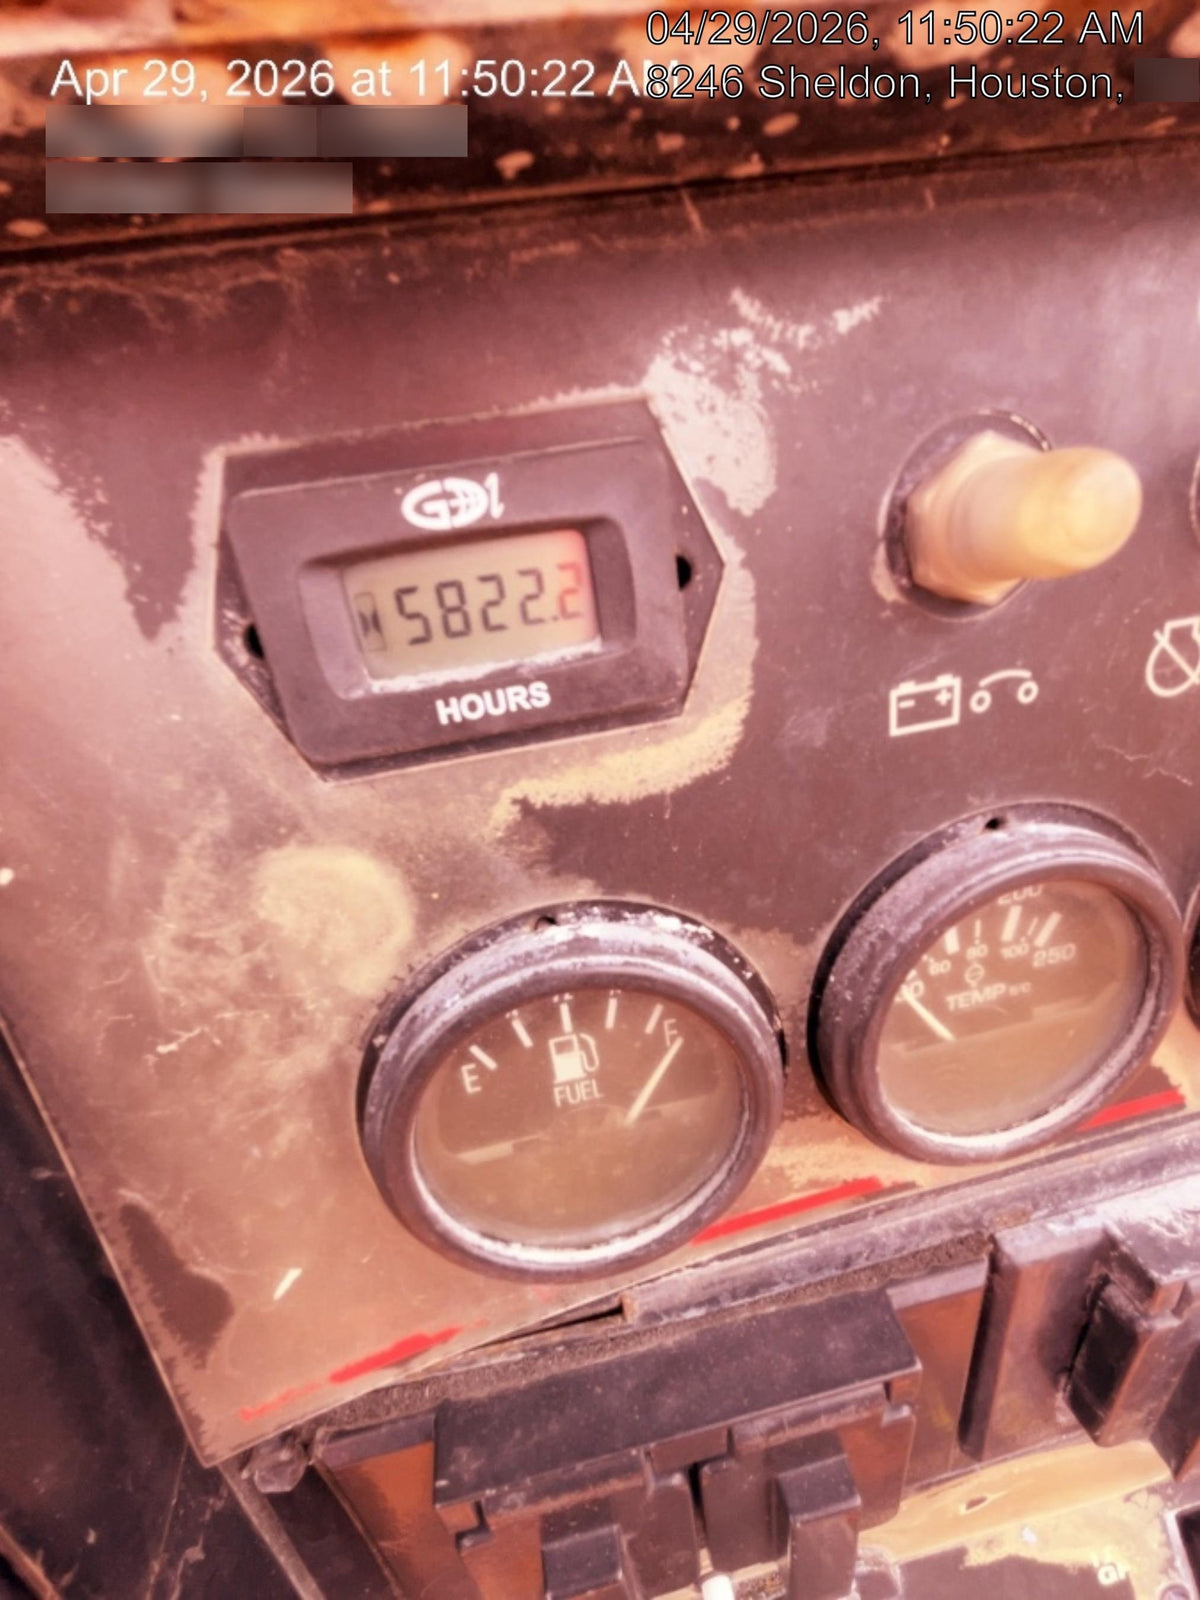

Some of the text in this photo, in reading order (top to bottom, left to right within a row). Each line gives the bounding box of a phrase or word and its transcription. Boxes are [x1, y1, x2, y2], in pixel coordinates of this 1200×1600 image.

[394, 561, 584, 646] 5822.2
[435, 681, 551, 725] HOURS
[946, 982, 1007, 1012] TEMP
[663, 1018, 679, 1047] F
[461, 1063, 482, 1094] E
[553, 1078, 604, 1107] FUEL
